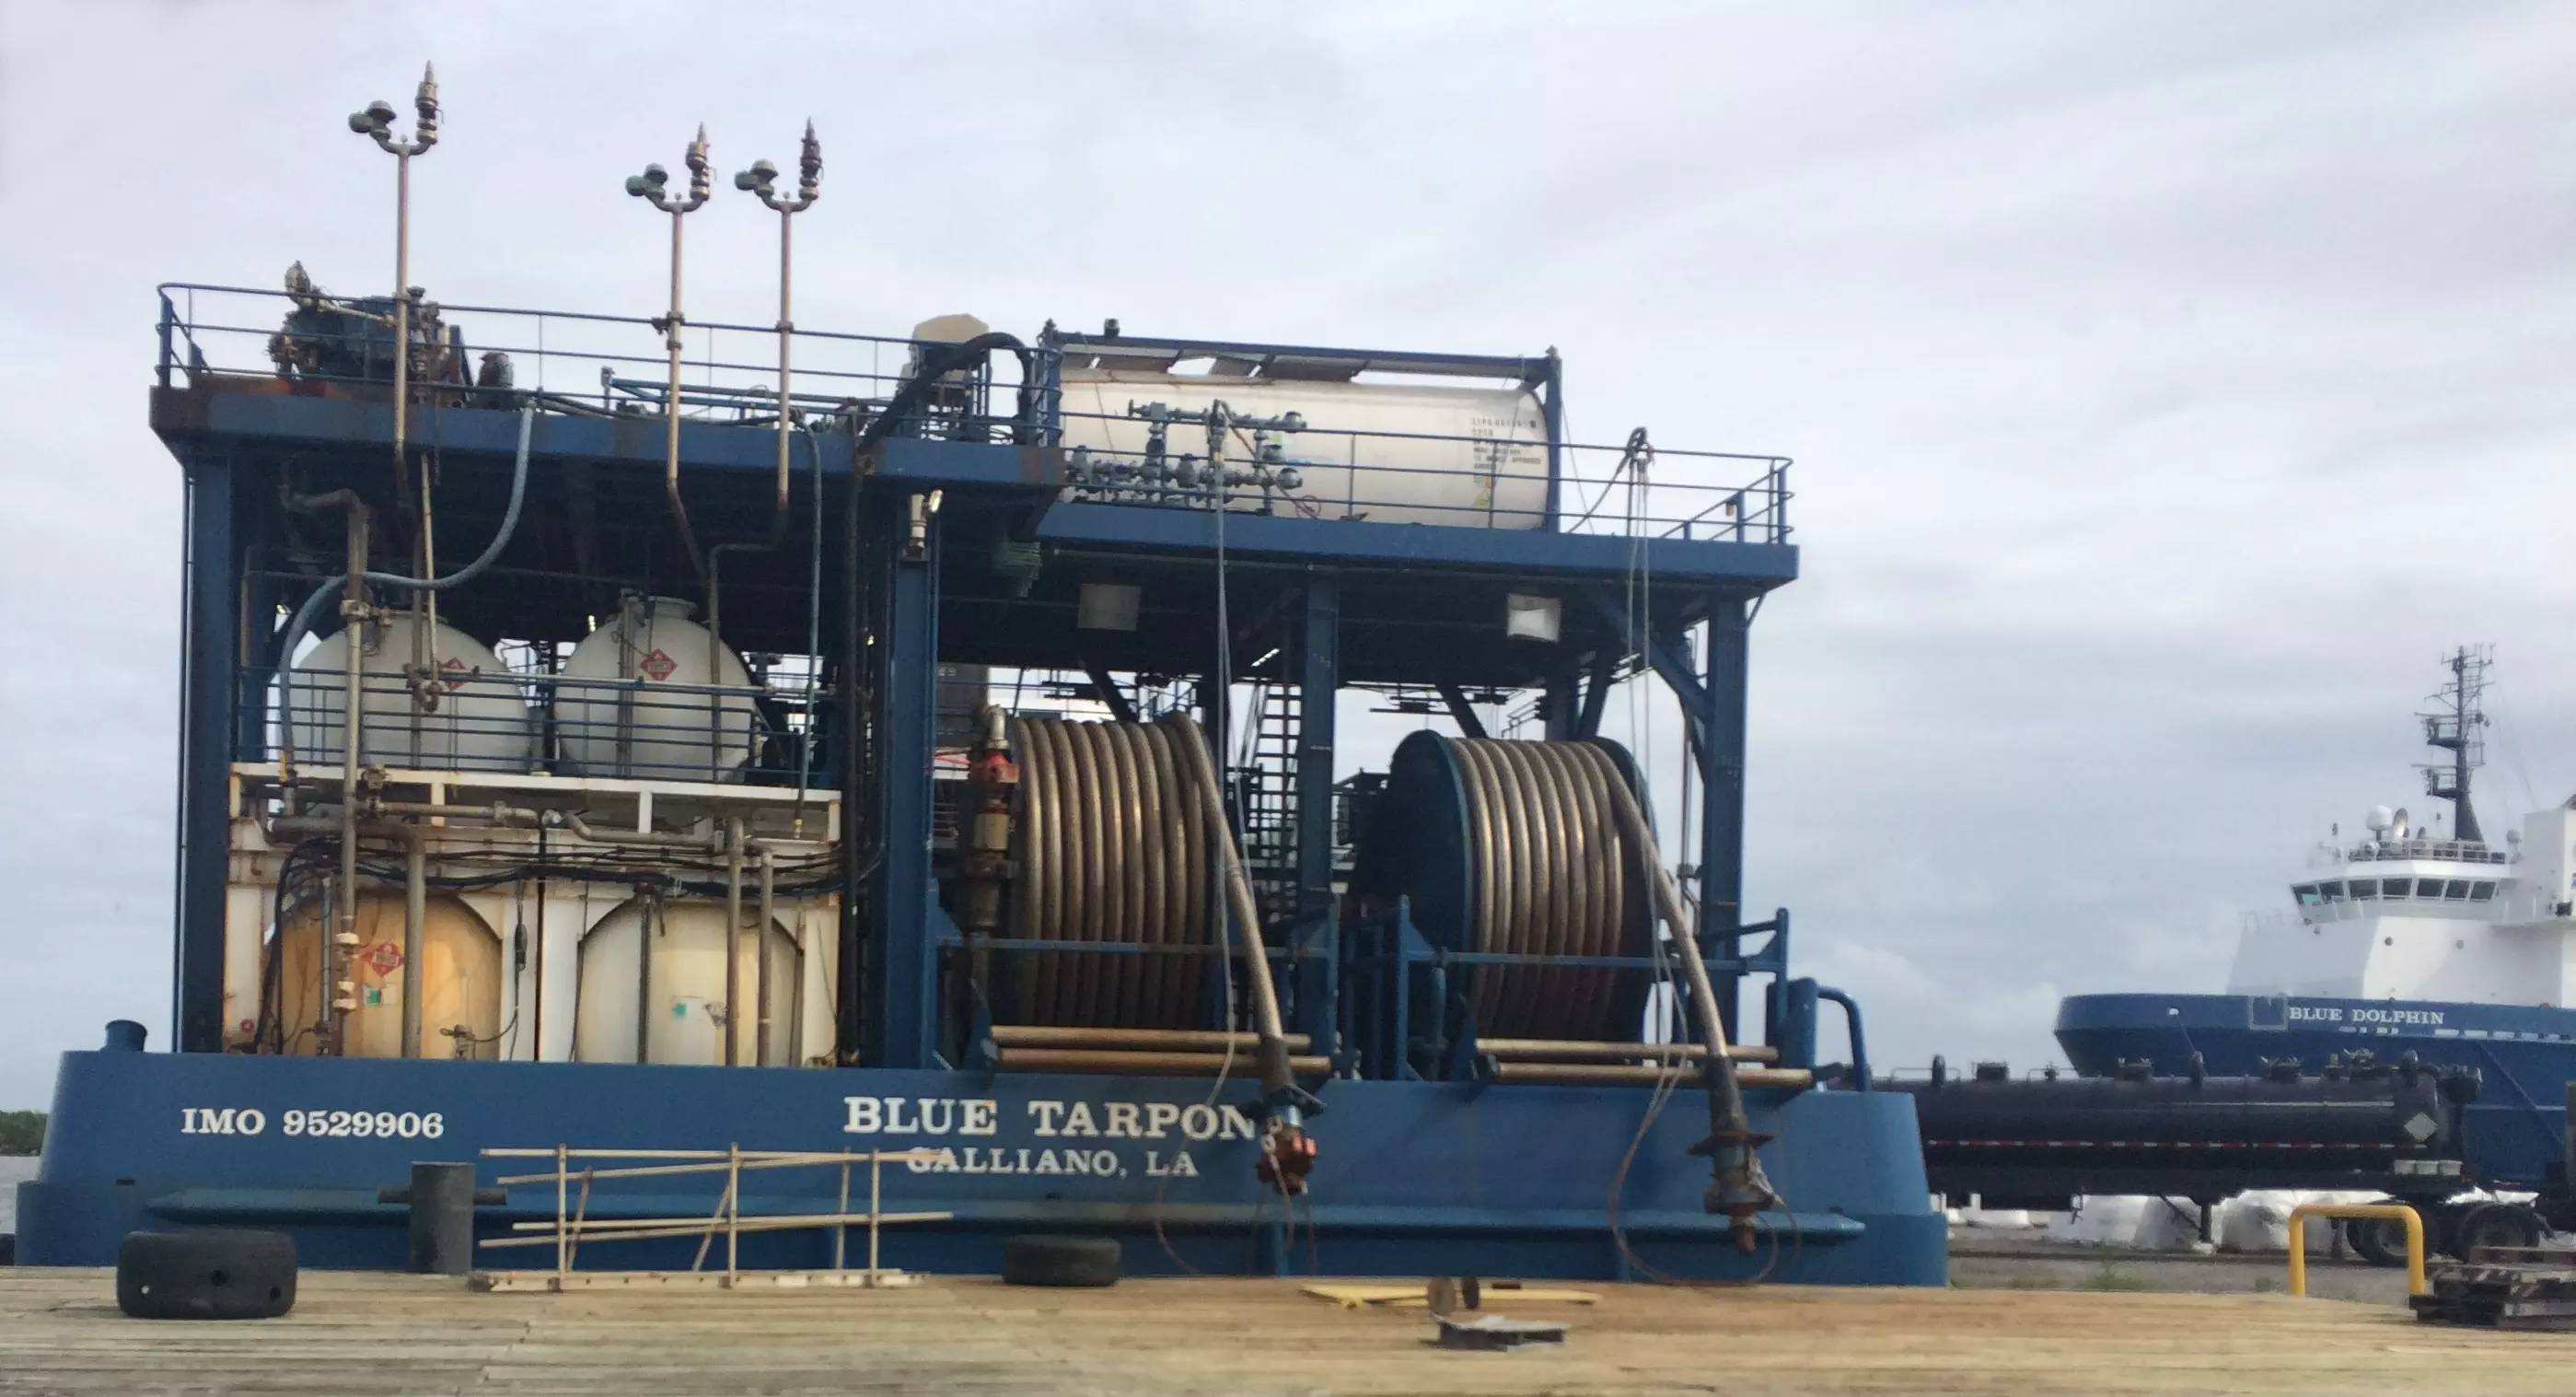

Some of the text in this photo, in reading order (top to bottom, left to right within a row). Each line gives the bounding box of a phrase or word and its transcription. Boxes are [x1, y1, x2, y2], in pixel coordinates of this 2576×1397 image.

[2289, 1007, 2444, 1025] BLUE DOLPHIN
[181, 1108, 444, 1138] IMO 9529906
[843, 1096, 1256, 1140] BLUE TARPON
[907, 1147, 1198, 1179] GALLIANO, LA
